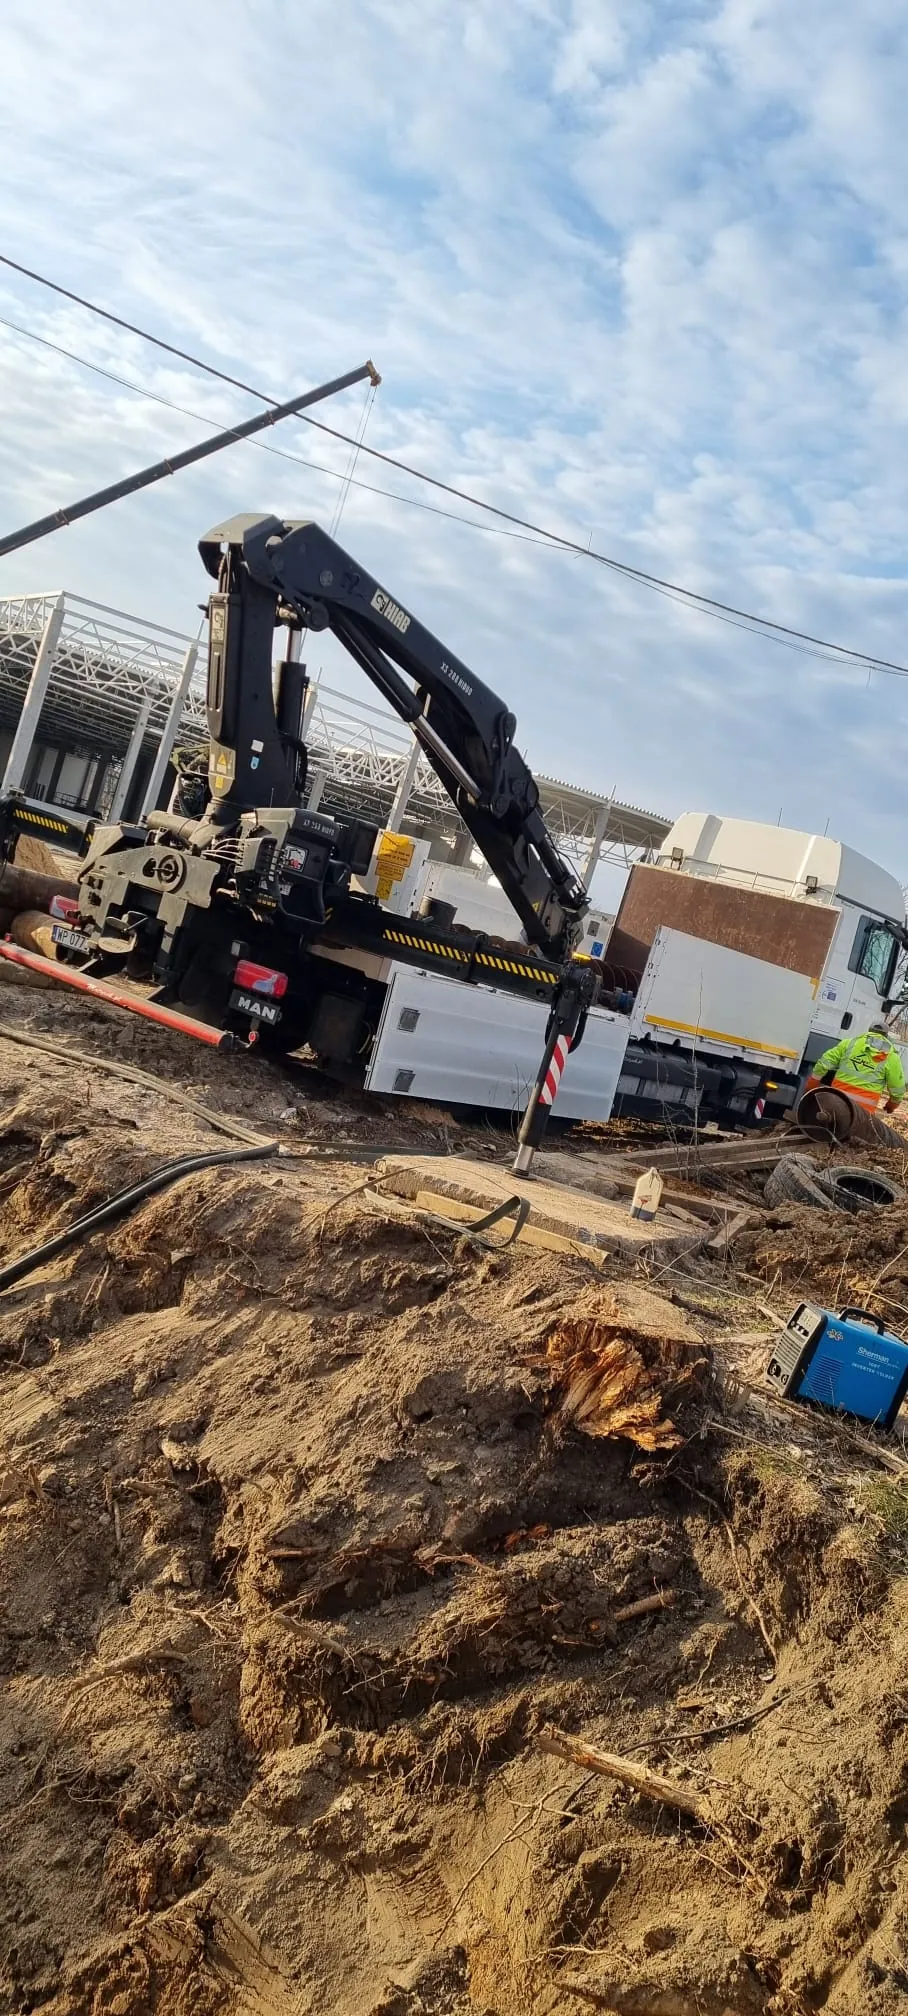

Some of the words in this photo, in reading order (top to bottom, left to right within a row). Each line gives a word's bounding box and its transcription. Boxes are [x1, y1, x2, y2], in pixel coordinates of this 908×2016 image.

[384, 601, 410, 633] HIAB
[57, 928, 69, 944] WP
[69, 933, 89, 951] 077
[238, 996, 276, 1020] MAN
[857, 1346, 889, 1362] Sherman
